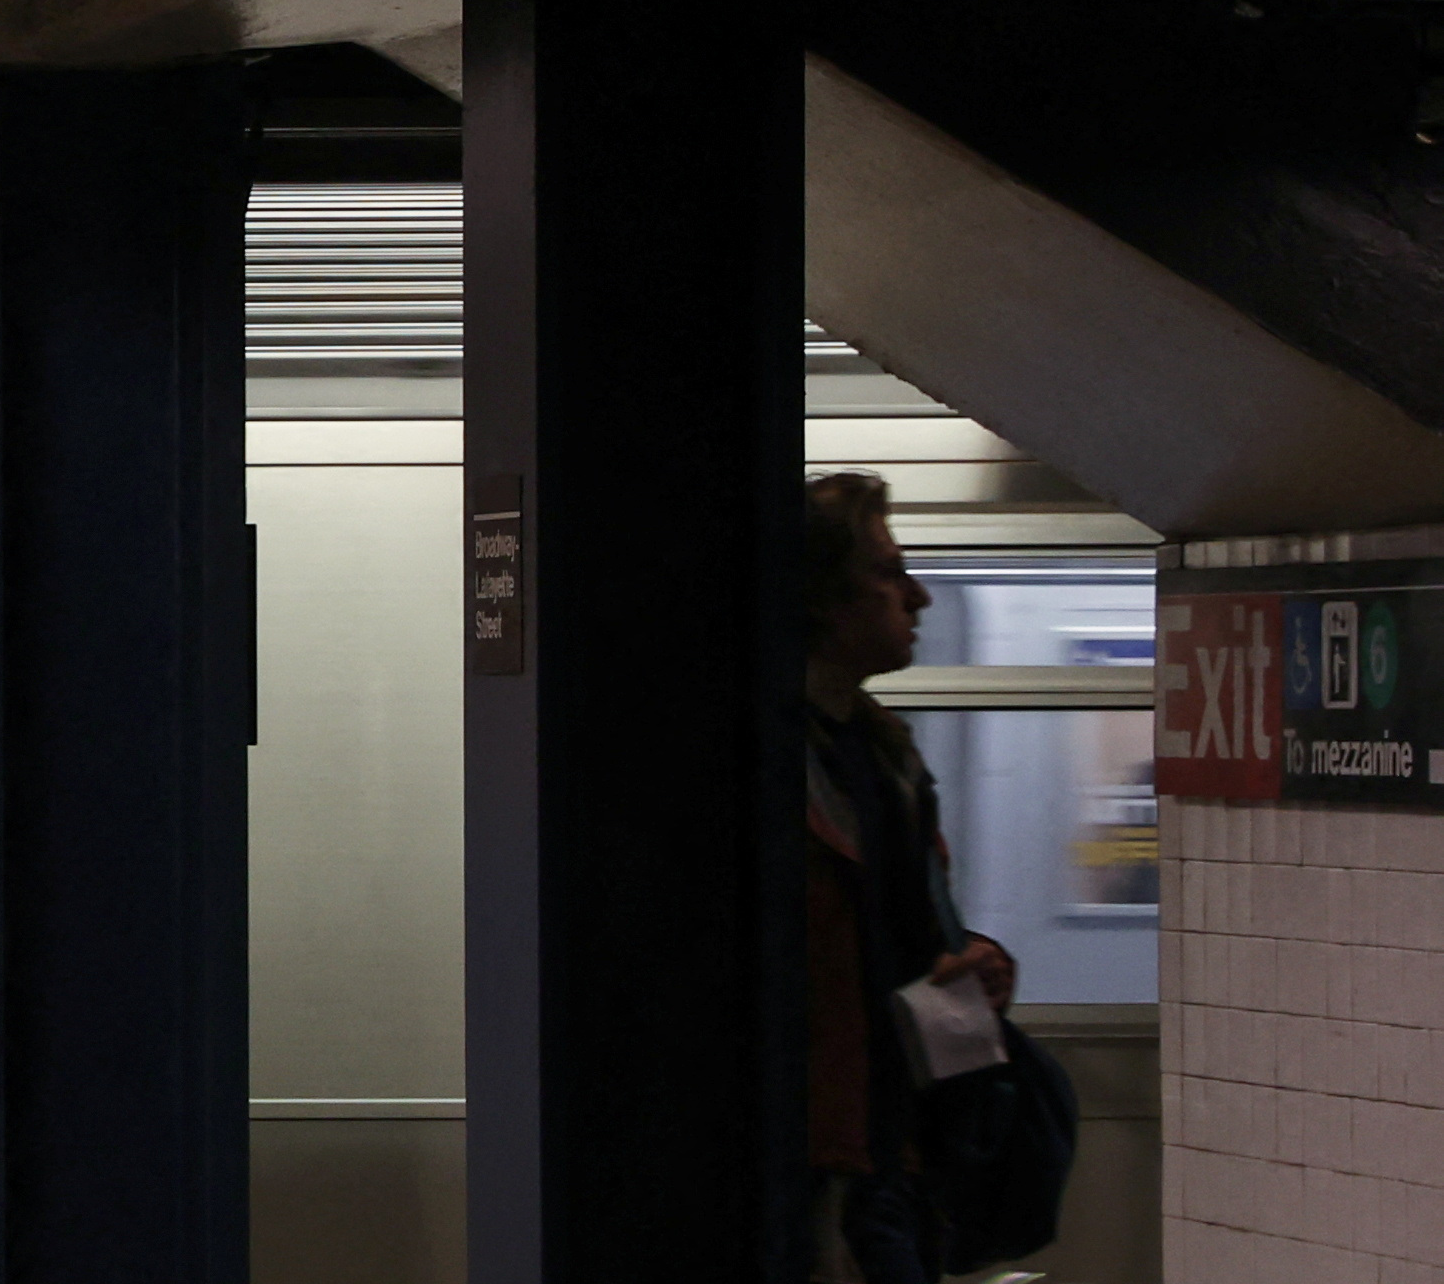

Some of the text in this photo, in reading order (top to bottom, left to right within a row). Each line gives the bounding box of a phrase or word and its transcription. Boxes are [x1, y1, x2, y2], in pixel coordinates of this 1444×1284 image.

[1156, 604, 1272, 760] Exit
[1369, 624, 1388, 684] 6
[1283, 728, 1414, 778] To mezzanine
